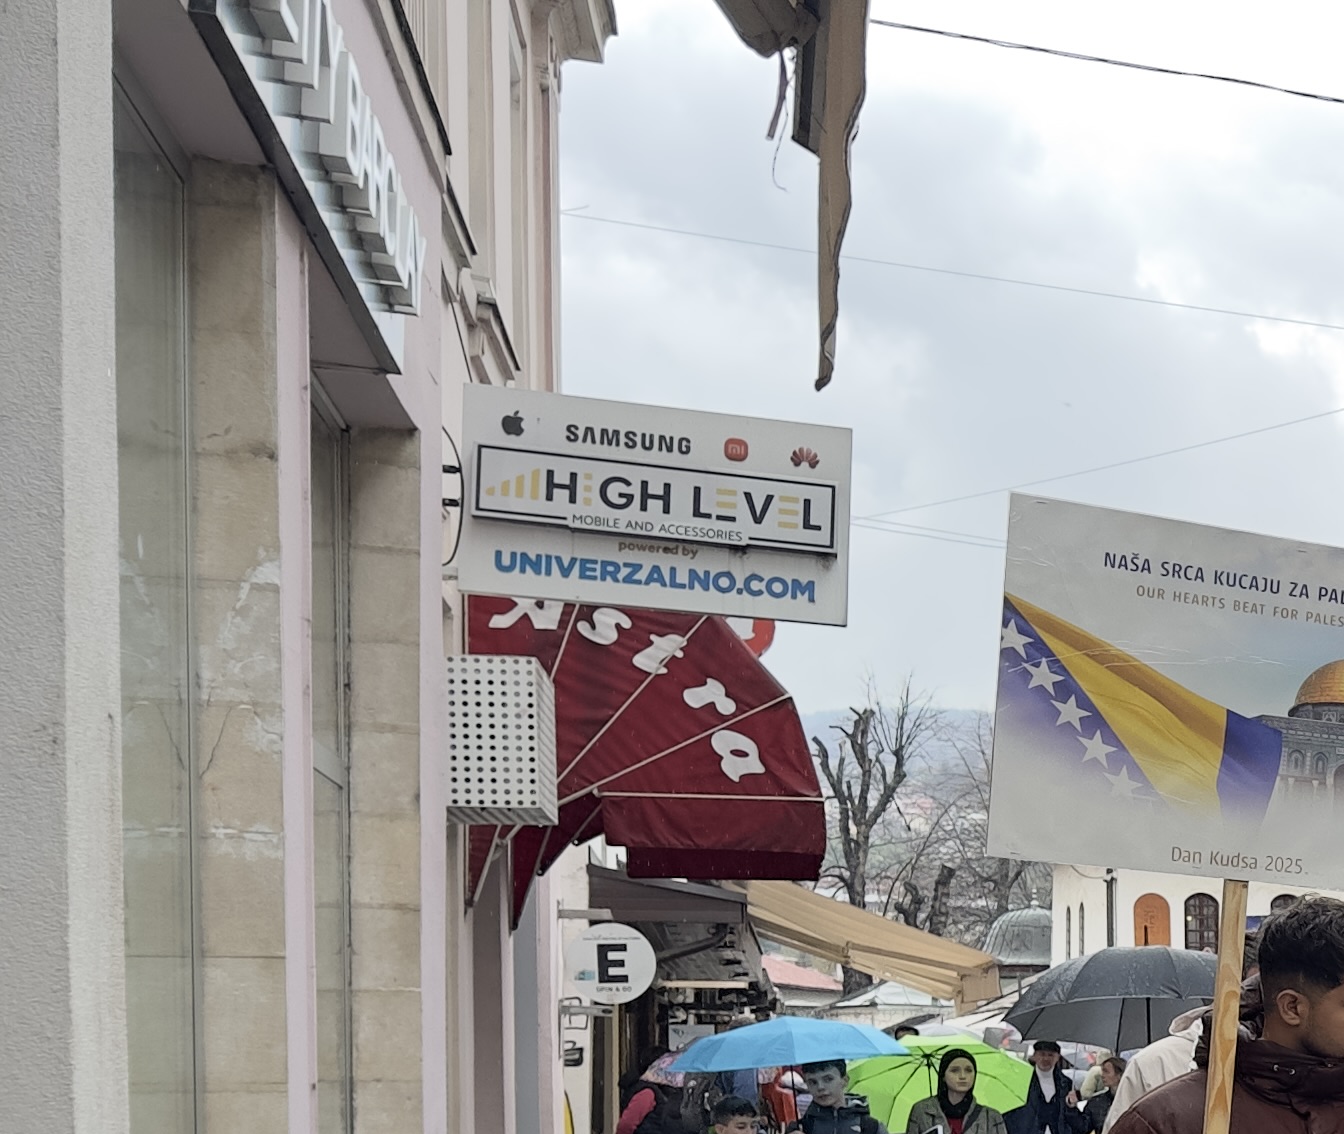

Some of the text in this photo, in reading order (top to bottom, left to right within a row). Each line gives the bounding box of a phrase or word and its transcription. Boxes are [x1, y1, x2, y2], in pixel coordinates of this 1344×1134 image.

[345, 50, 427, 318] BARCLAY
[565, 423, 692, 455] SAMSUNG
[572, 513, 743, 543] MOBILE AND ACCESSORIES
[618, 541, 699, 561] powered by
[494, 549, 816, 604] UNIVERZALNO.COM
[1103, 550, 1153, 576] NAŠA
[1160, 560, 1206, 584] SRCA
[1213, 569, 1282, 596] KUCAJU
[1288, 580, 1310, 600] ZA
[1136, 584, 1167, 601] OUR
[1172, 590, 1227, 610] HEARTS
[1232, 599, 1267, 617] BEAT
[1272, 604, 1300, 622] FOR
[1171, 845, 1309, 877] Dan Kudsa 2025.
[597, 943, 629, 984] E
